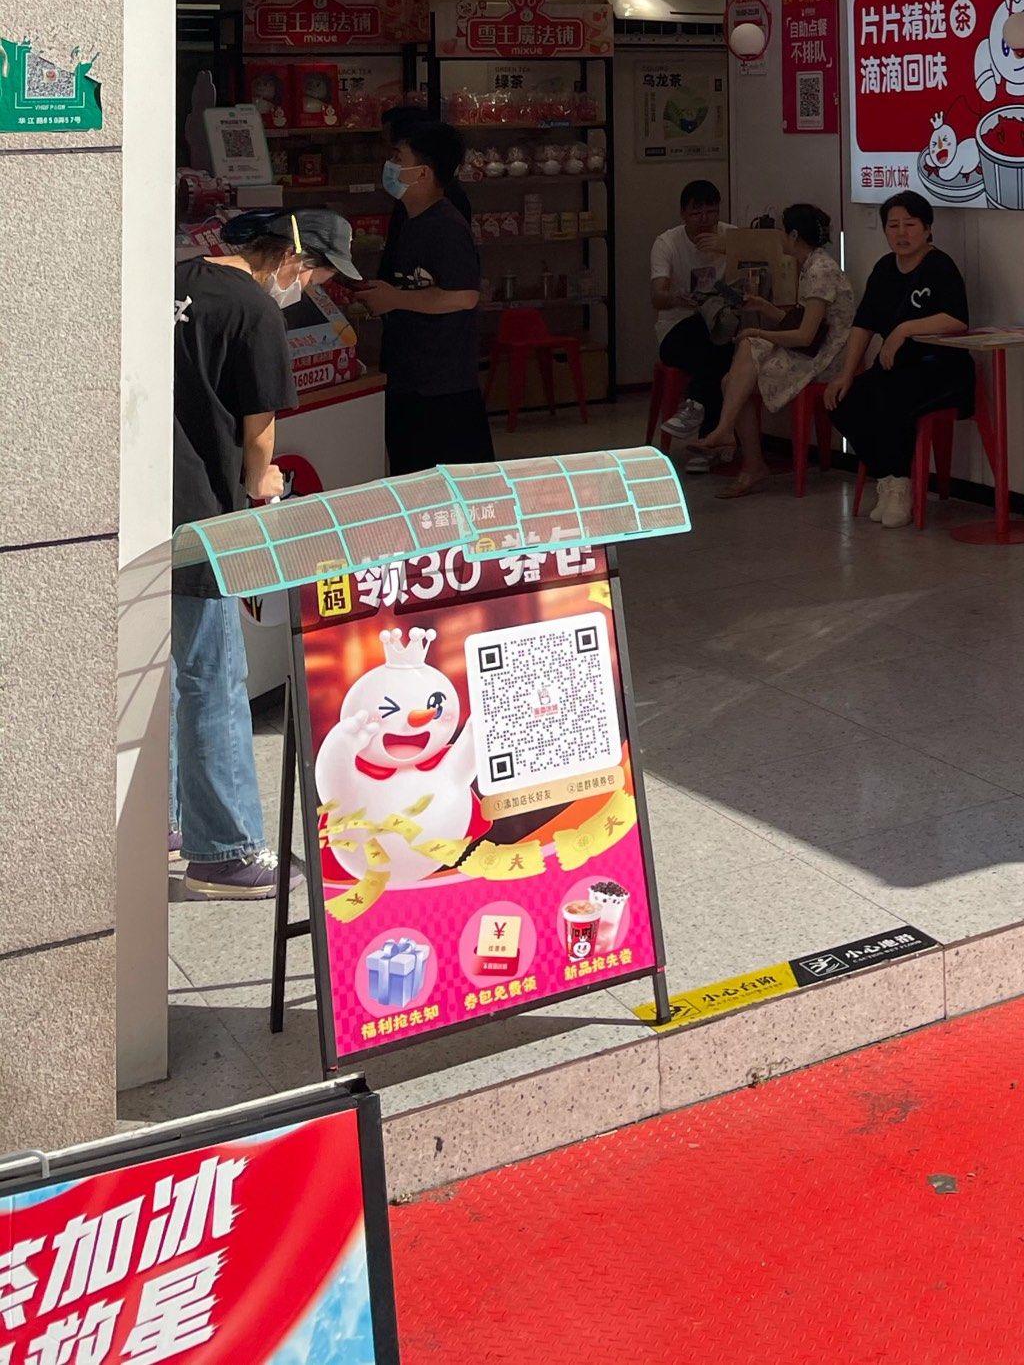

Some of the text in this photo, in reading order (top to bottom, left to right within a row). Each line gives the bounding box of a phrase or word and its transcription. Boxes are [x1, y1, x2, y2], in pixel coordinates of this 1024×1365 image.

[266, 10, 373, 34] 雪王魔法铺
[954, 3, 971, 33] 茶
[303, 33, 338, 44] mixue
[477, 24, 575, 46] 雪王魔法铺
[511, 46, 543, 56] mixue
[494, 74, 525, 90] 绿茶
[642, 73, 682, 88] 乌龙茶
[860, 51, 948, 95] 滴滴回味
[861, 165, 910, 189] 蜜雪冰城
[563, 948, 634, 982] 新品抢先尝
[463, 976, 538, 1011] 券包免费领
[702, 973, 778, 1003] 小心台阶
[360, 1004, 440, 1041] 福利抢先知
